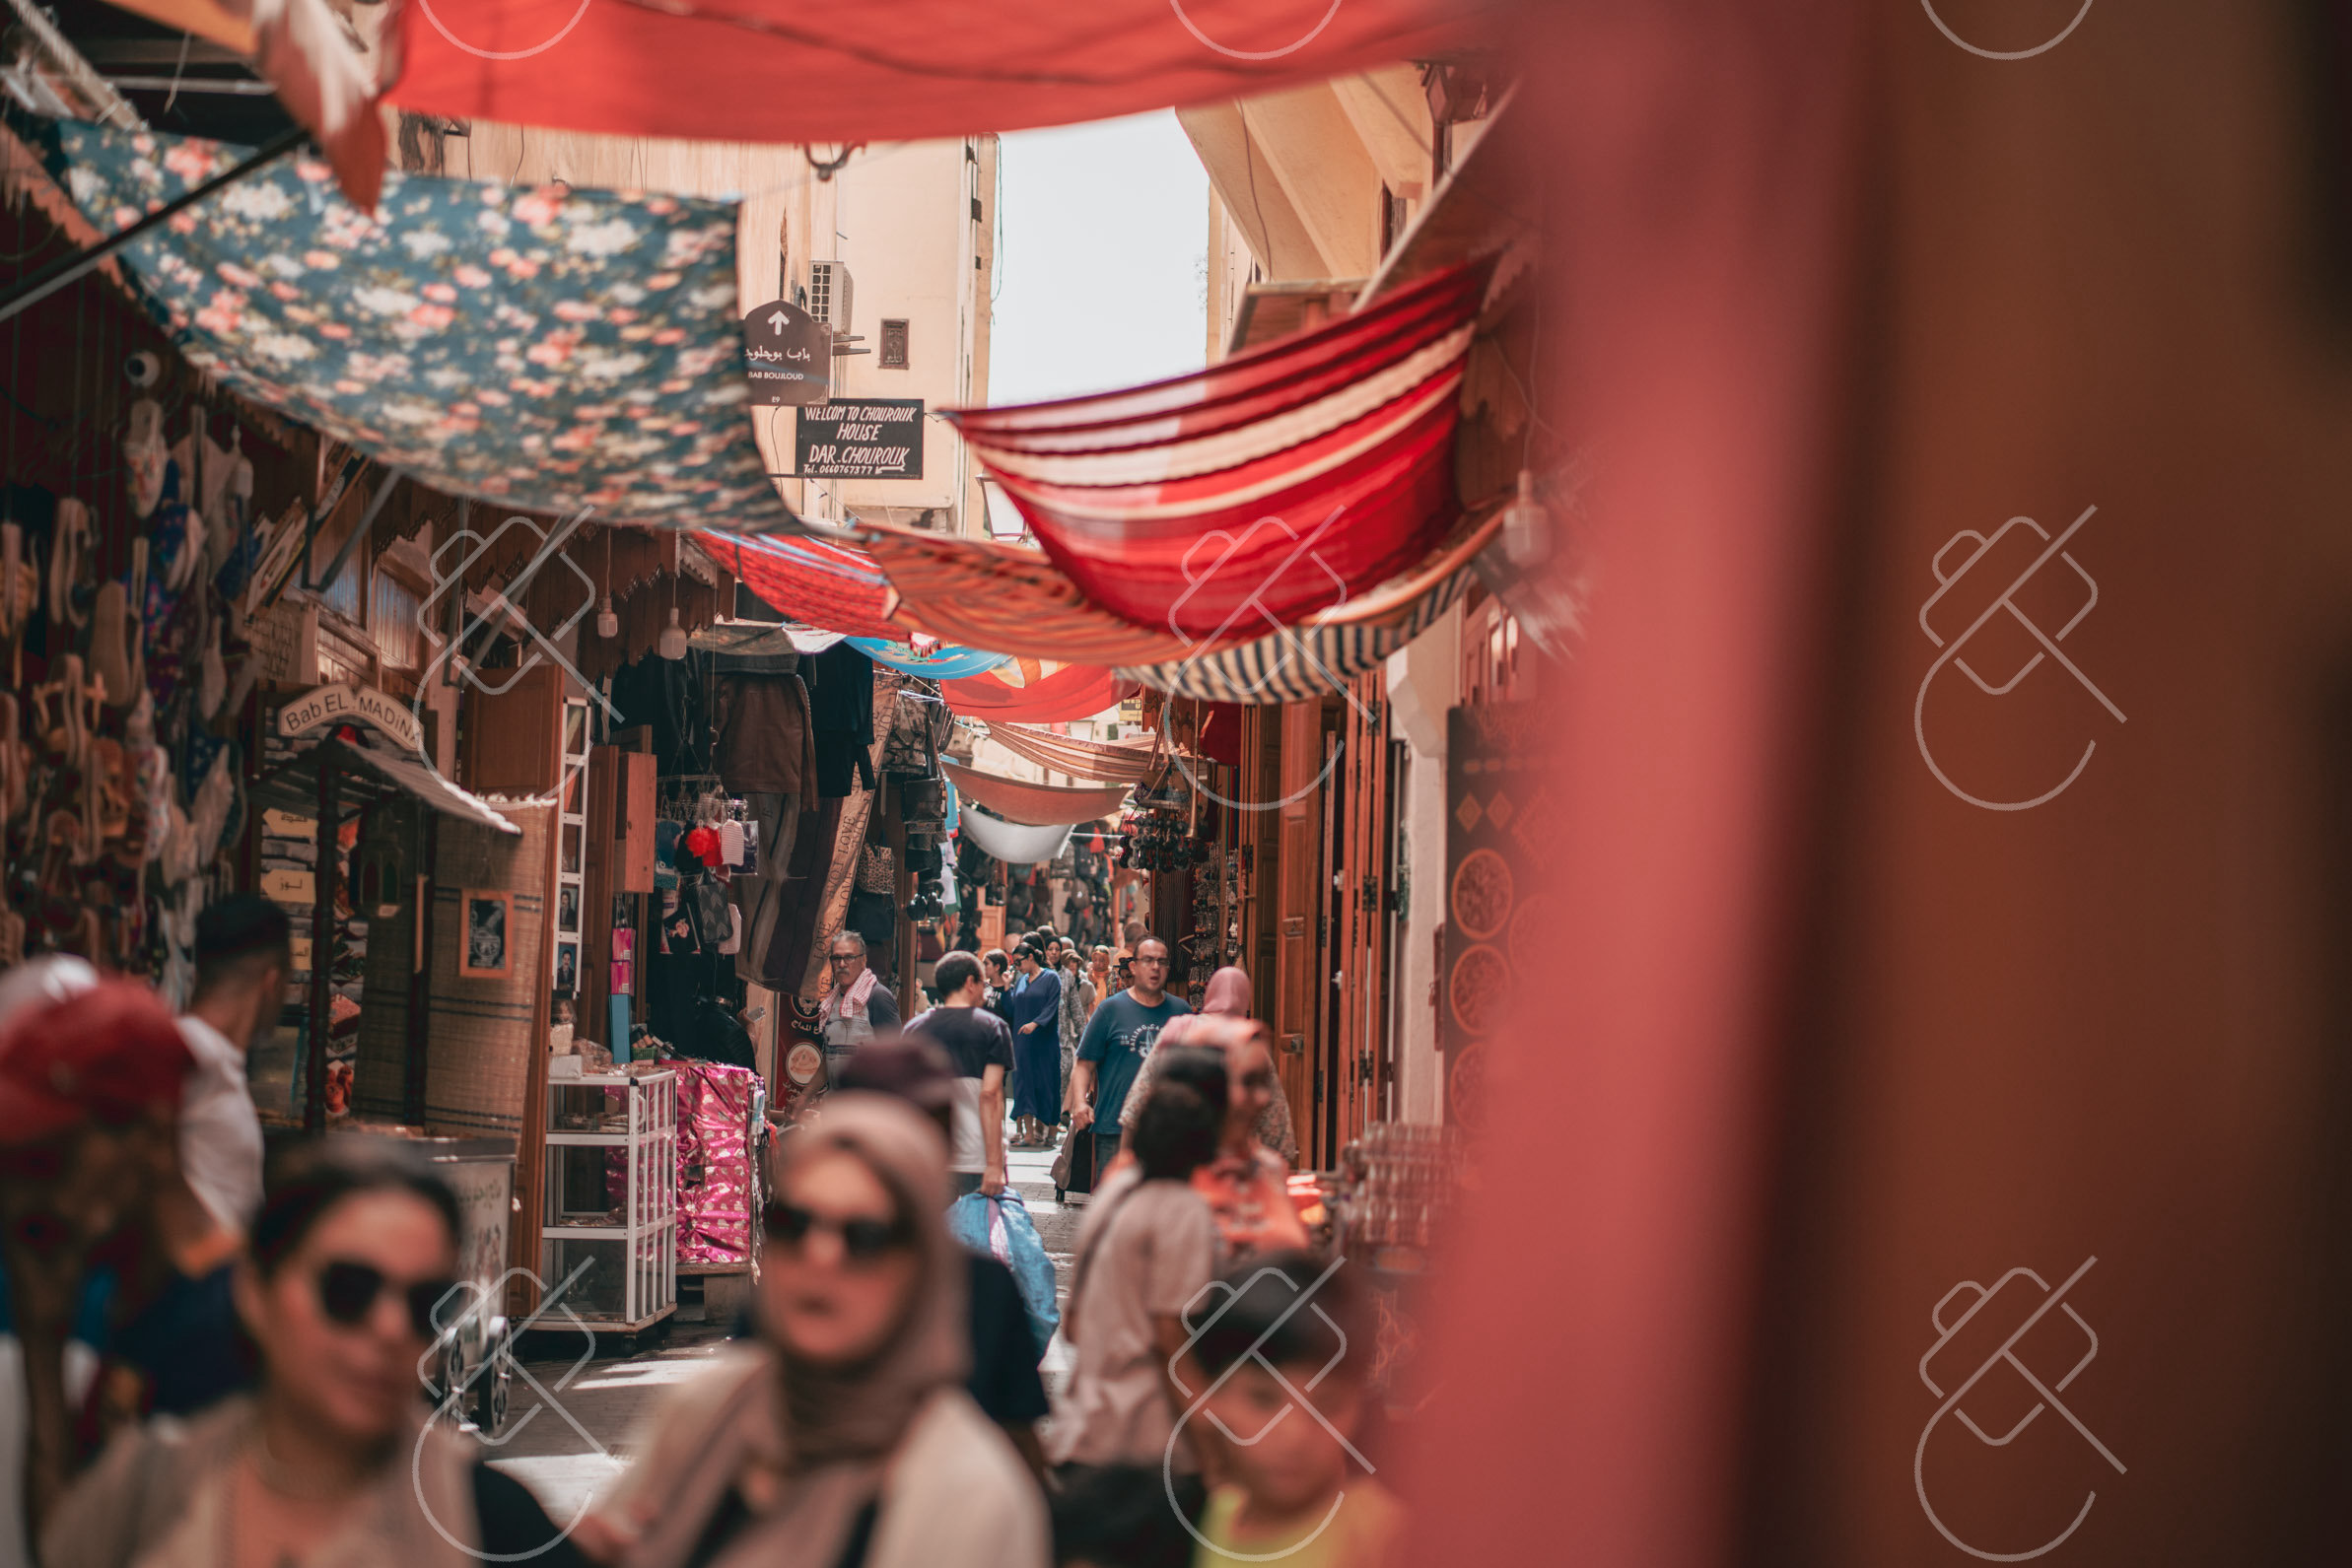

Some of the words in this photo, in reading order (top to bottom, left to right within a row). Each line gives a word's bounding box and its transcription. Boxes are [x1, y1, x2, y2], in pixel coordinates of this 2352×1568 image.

[787, 347, 810, 362] باب
[748, 371, 763, 379] BAB
[764, 372, 804, 380] BOUJLOUD
[804, 405, 846, 421] WELCOM
[847, 405, 860, 421] TO
[860, 406, 917, 422] CHOUROUK
[836, 423, 882, 442] HOUSE
[819, 464, 872, 474] 0660767377
[286, 702, 322, 731] Bab
[324, 693, 348, 713] EL
[837, 816, 855, 854] LOVE
[813, 921, 831, 960] LOVE
